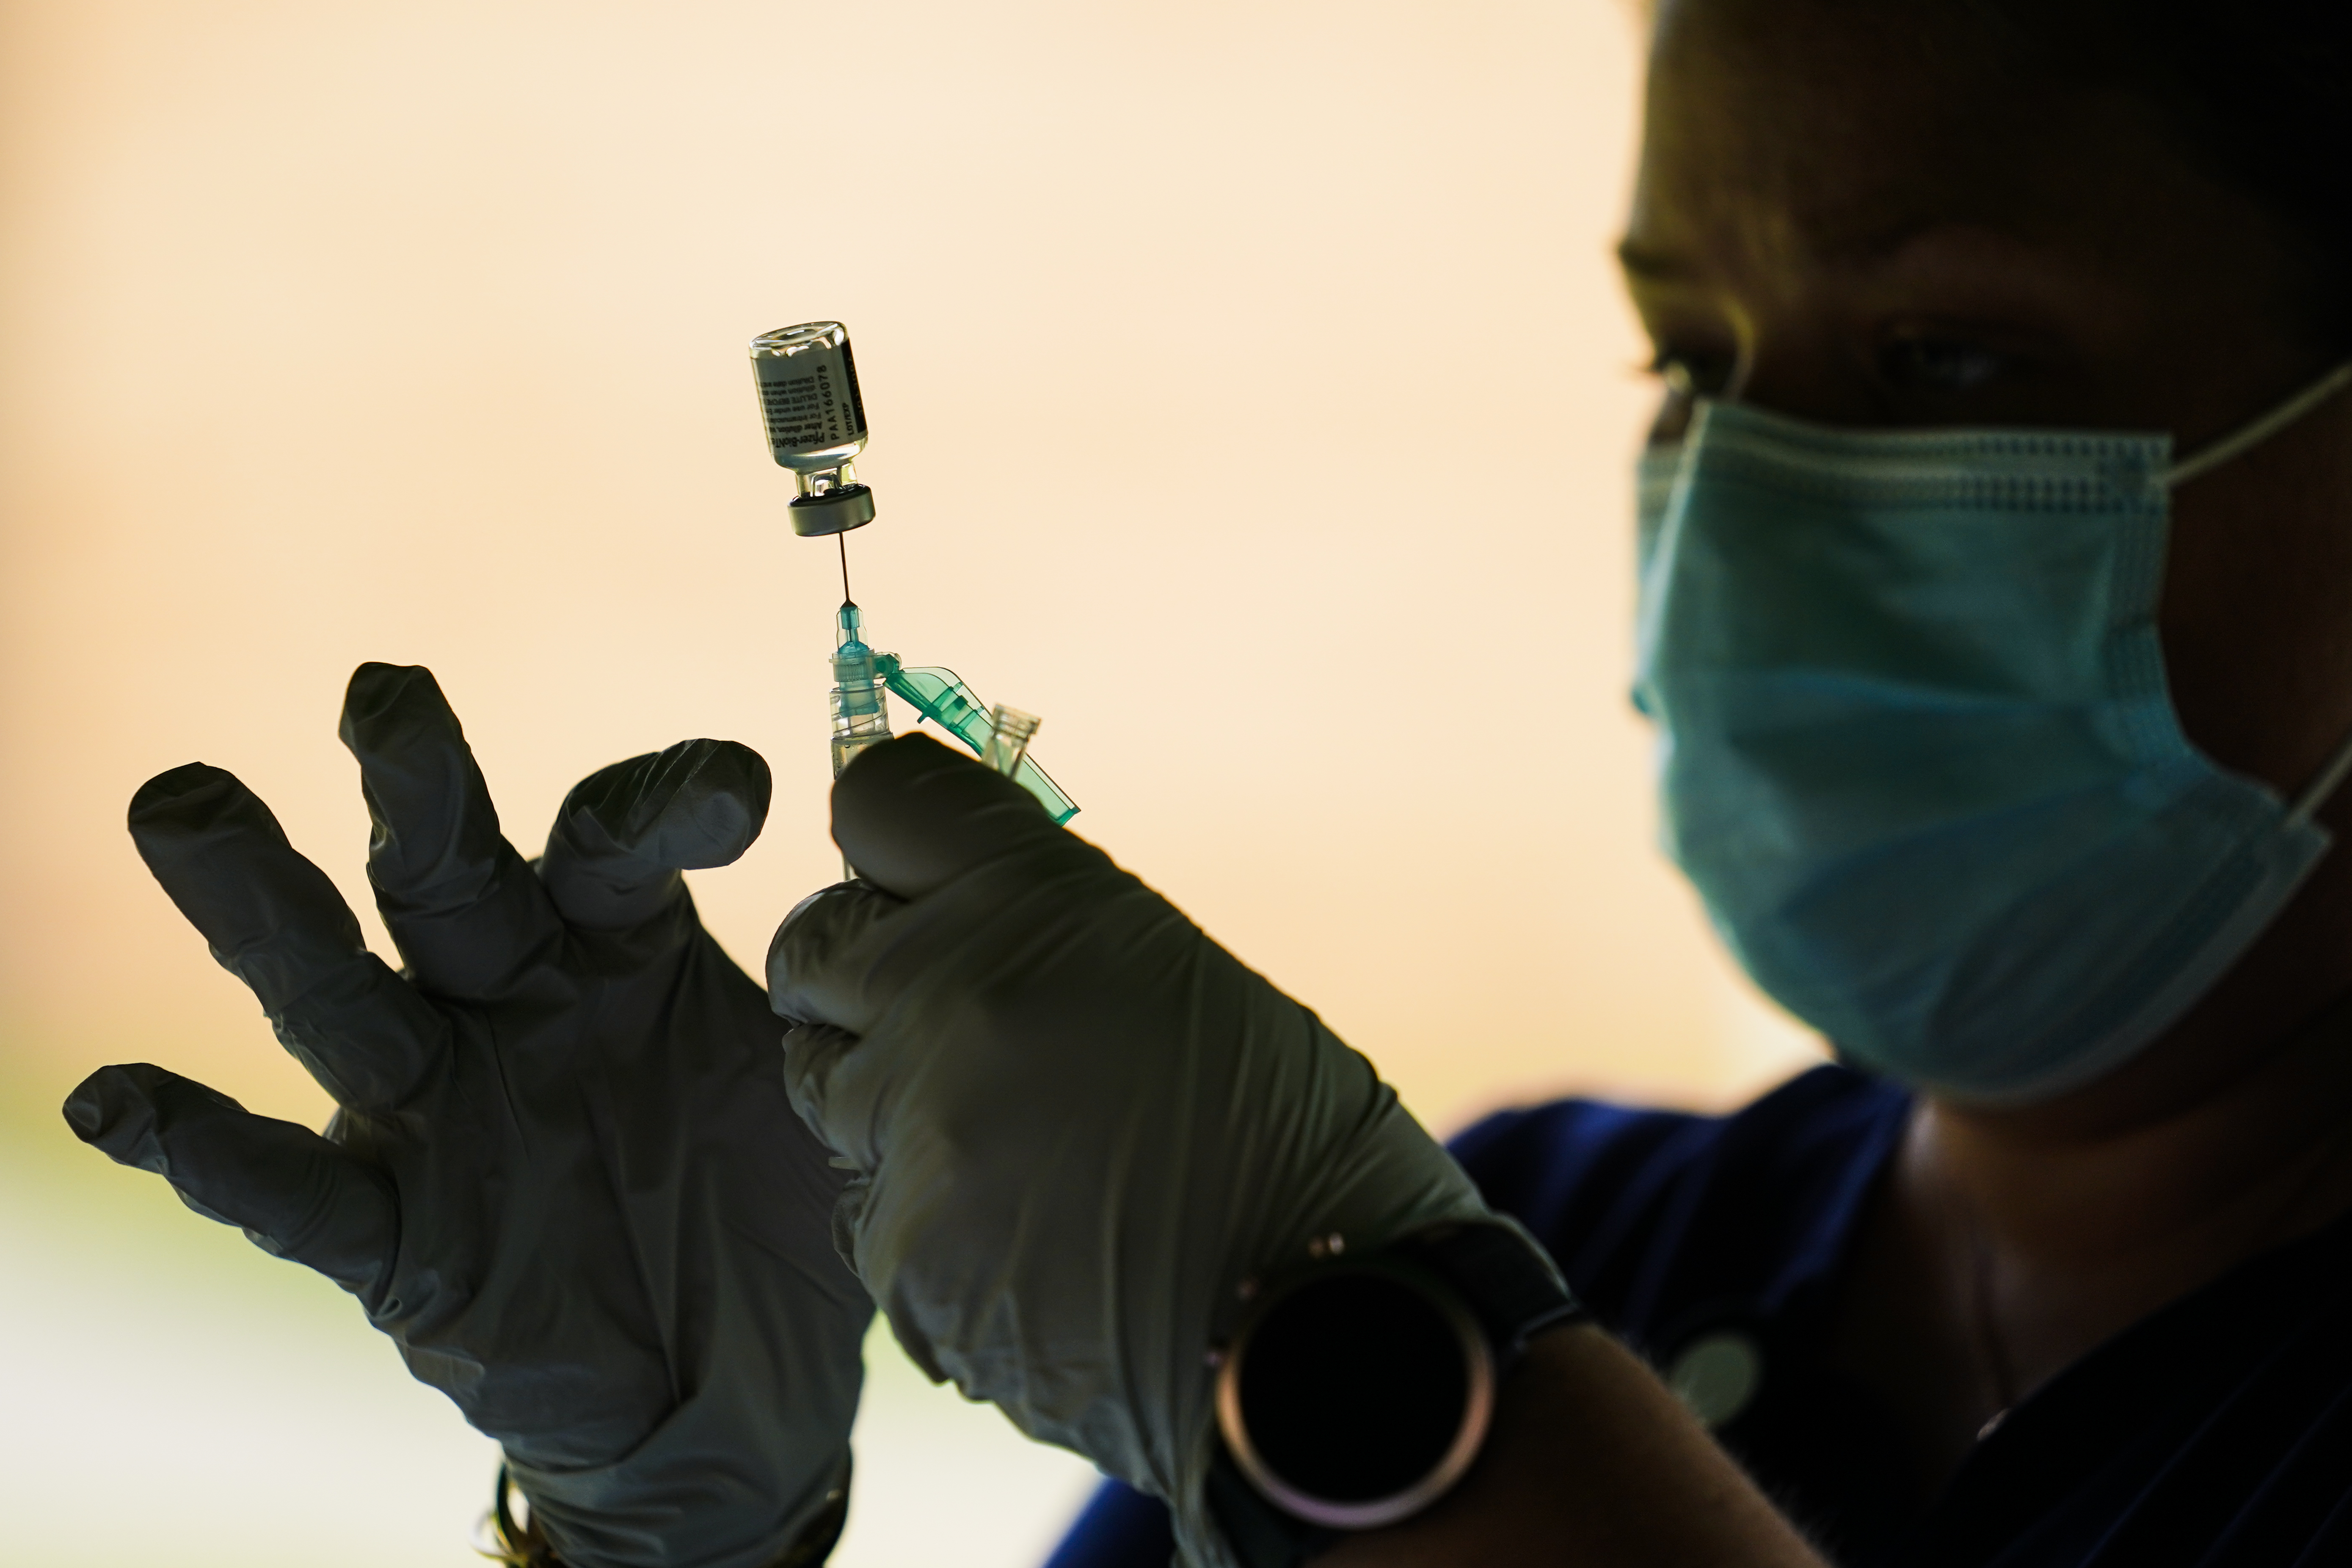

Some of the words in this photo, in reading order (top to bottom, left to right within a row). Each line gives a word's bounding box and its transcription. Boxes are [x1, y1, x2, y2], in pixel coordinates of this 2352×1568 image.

[791, 393, 818, 404] DILUTE
[816, 365, 840, 440] PAA166078
[804, 422, 823, 430] After
[842, 403, 854, 435] LOT/EXP
